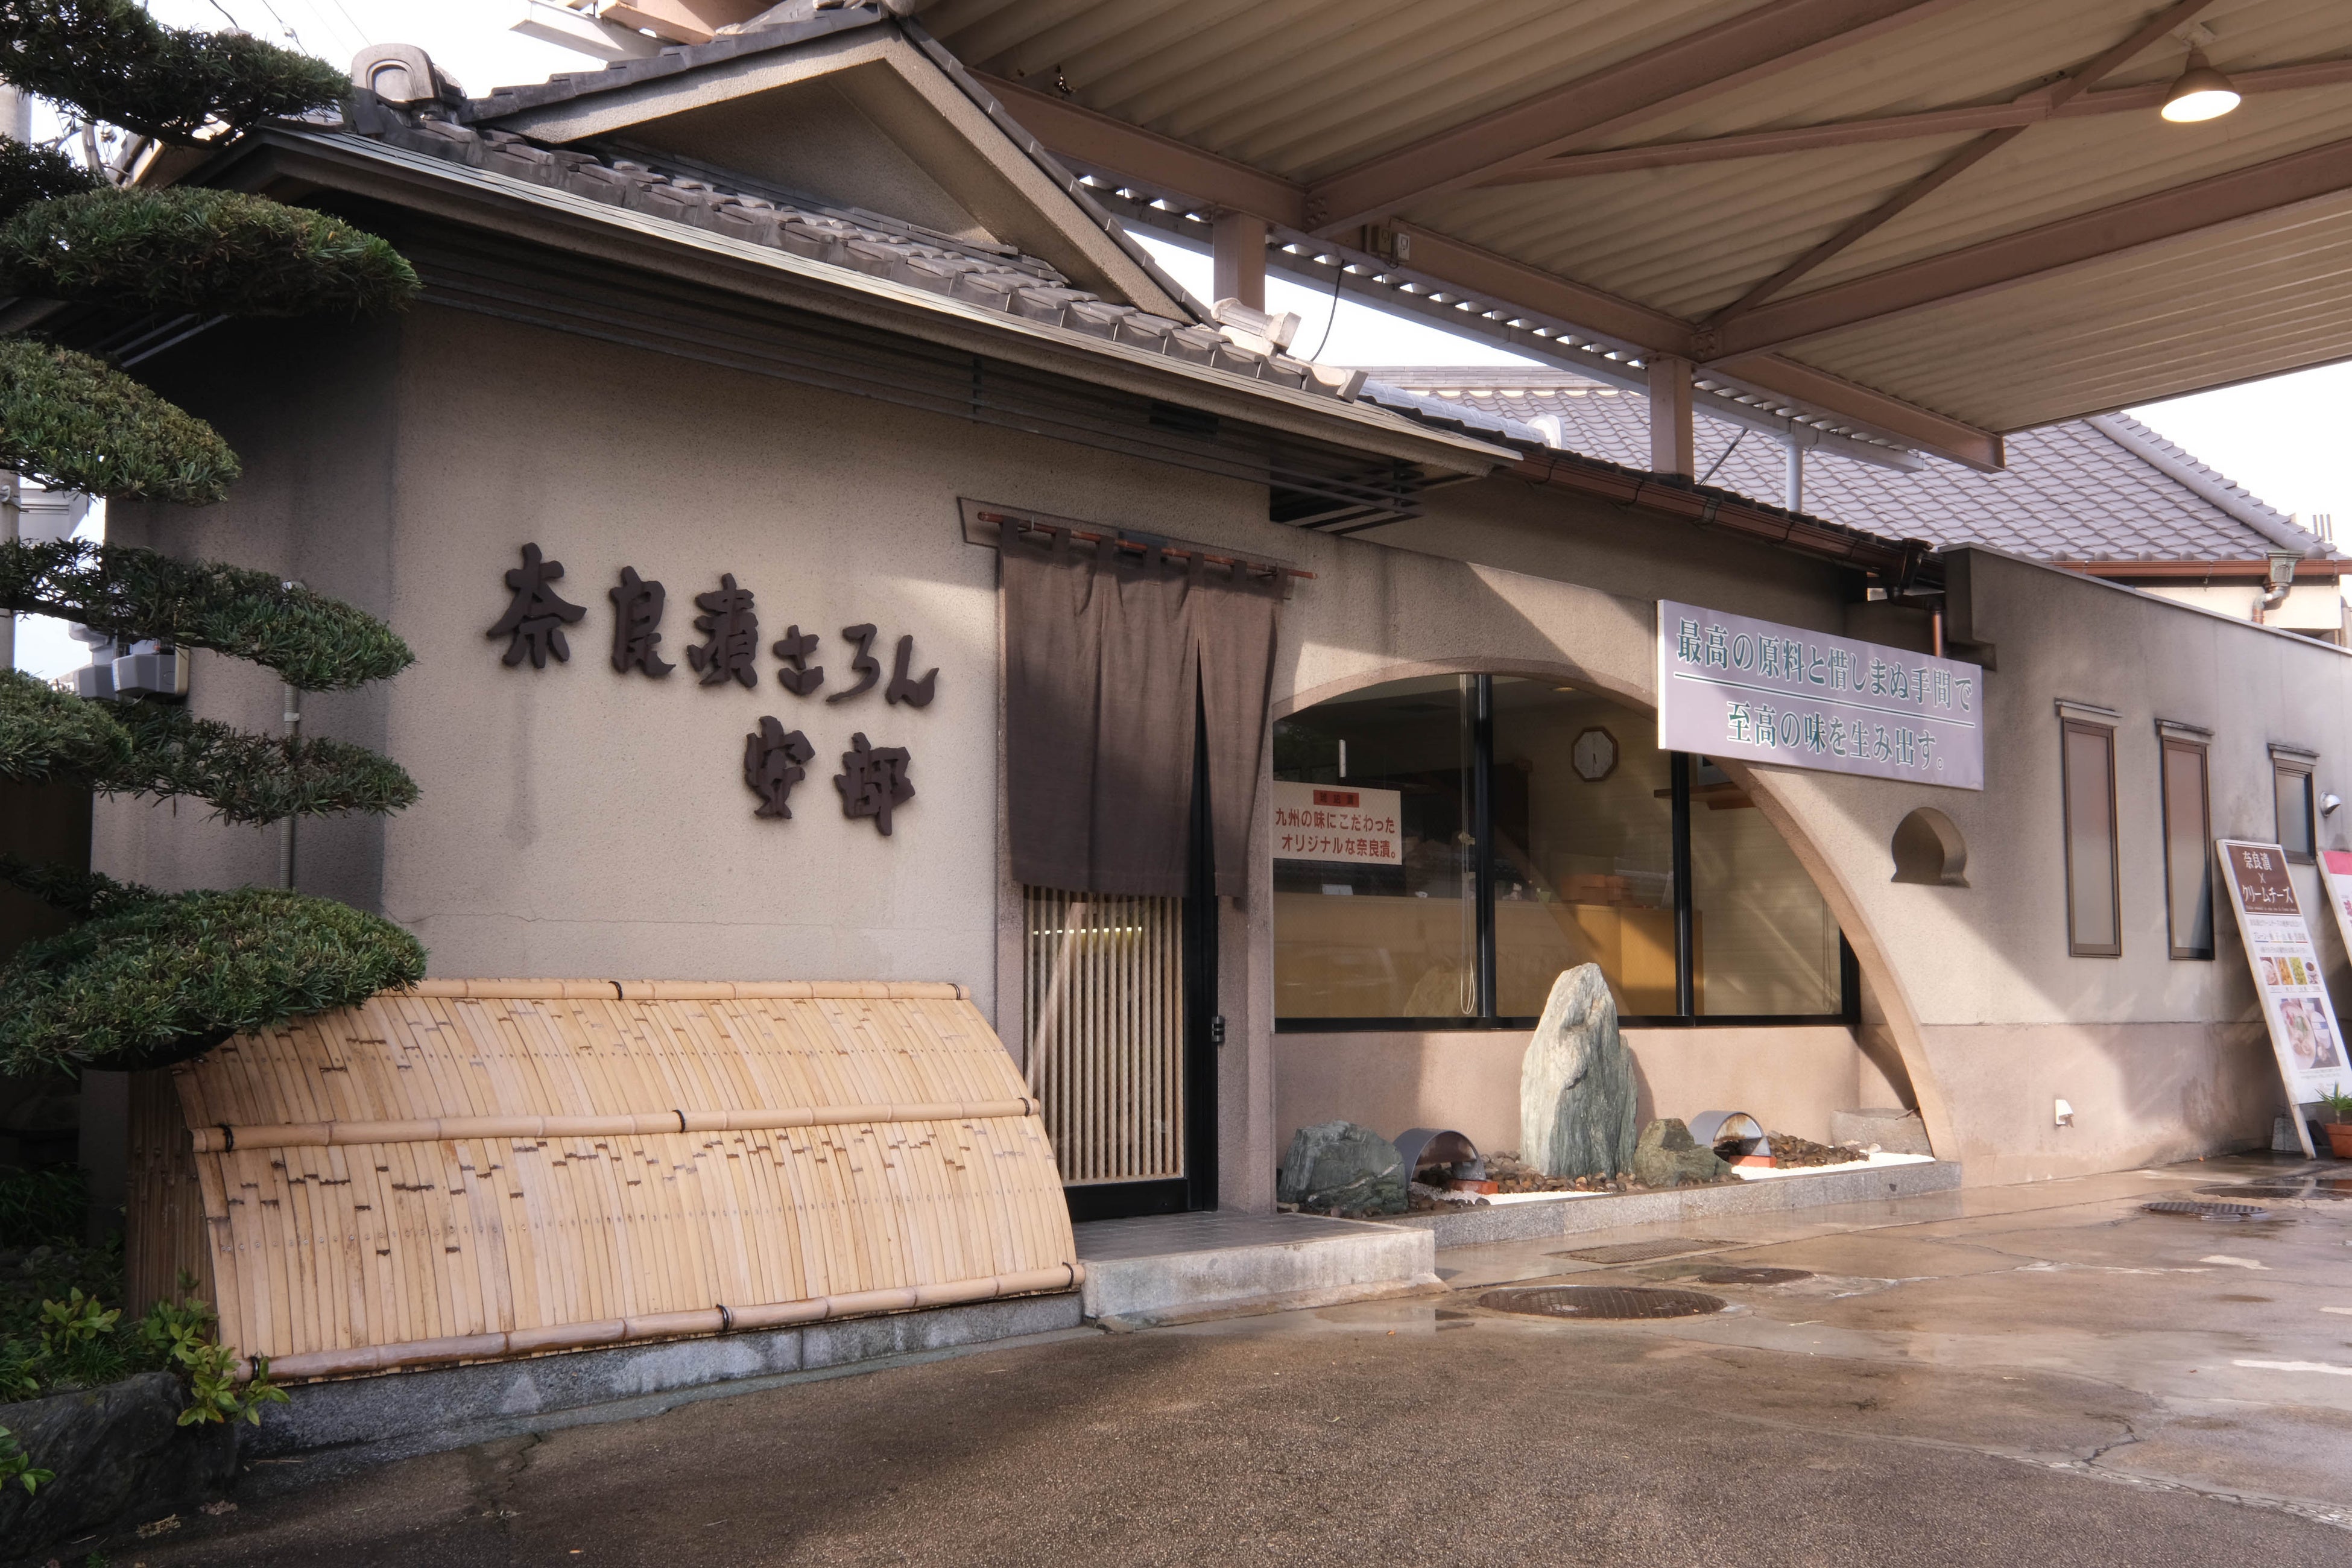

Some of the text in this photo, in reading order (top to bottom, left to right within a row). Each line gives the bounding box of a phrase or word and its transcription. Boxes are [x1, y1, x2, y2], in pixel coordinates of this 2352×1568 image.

[486, 542, 940, 707] 奈良漬さろん
[1677, 616, 1973, 712] 最高の原料と惜しまぬ手間で
[1727, 701, 1944, 771] 至高の味を生み出す。
[1276, 808, 1395, 834] 九州の味にこだわった
[1282, 833, 1396, 859] オリジナルな奈良漬。
[2242, 851, 2272, 871] 奈良漬
[2242, 885, 2294, 903] クリームチーズ
